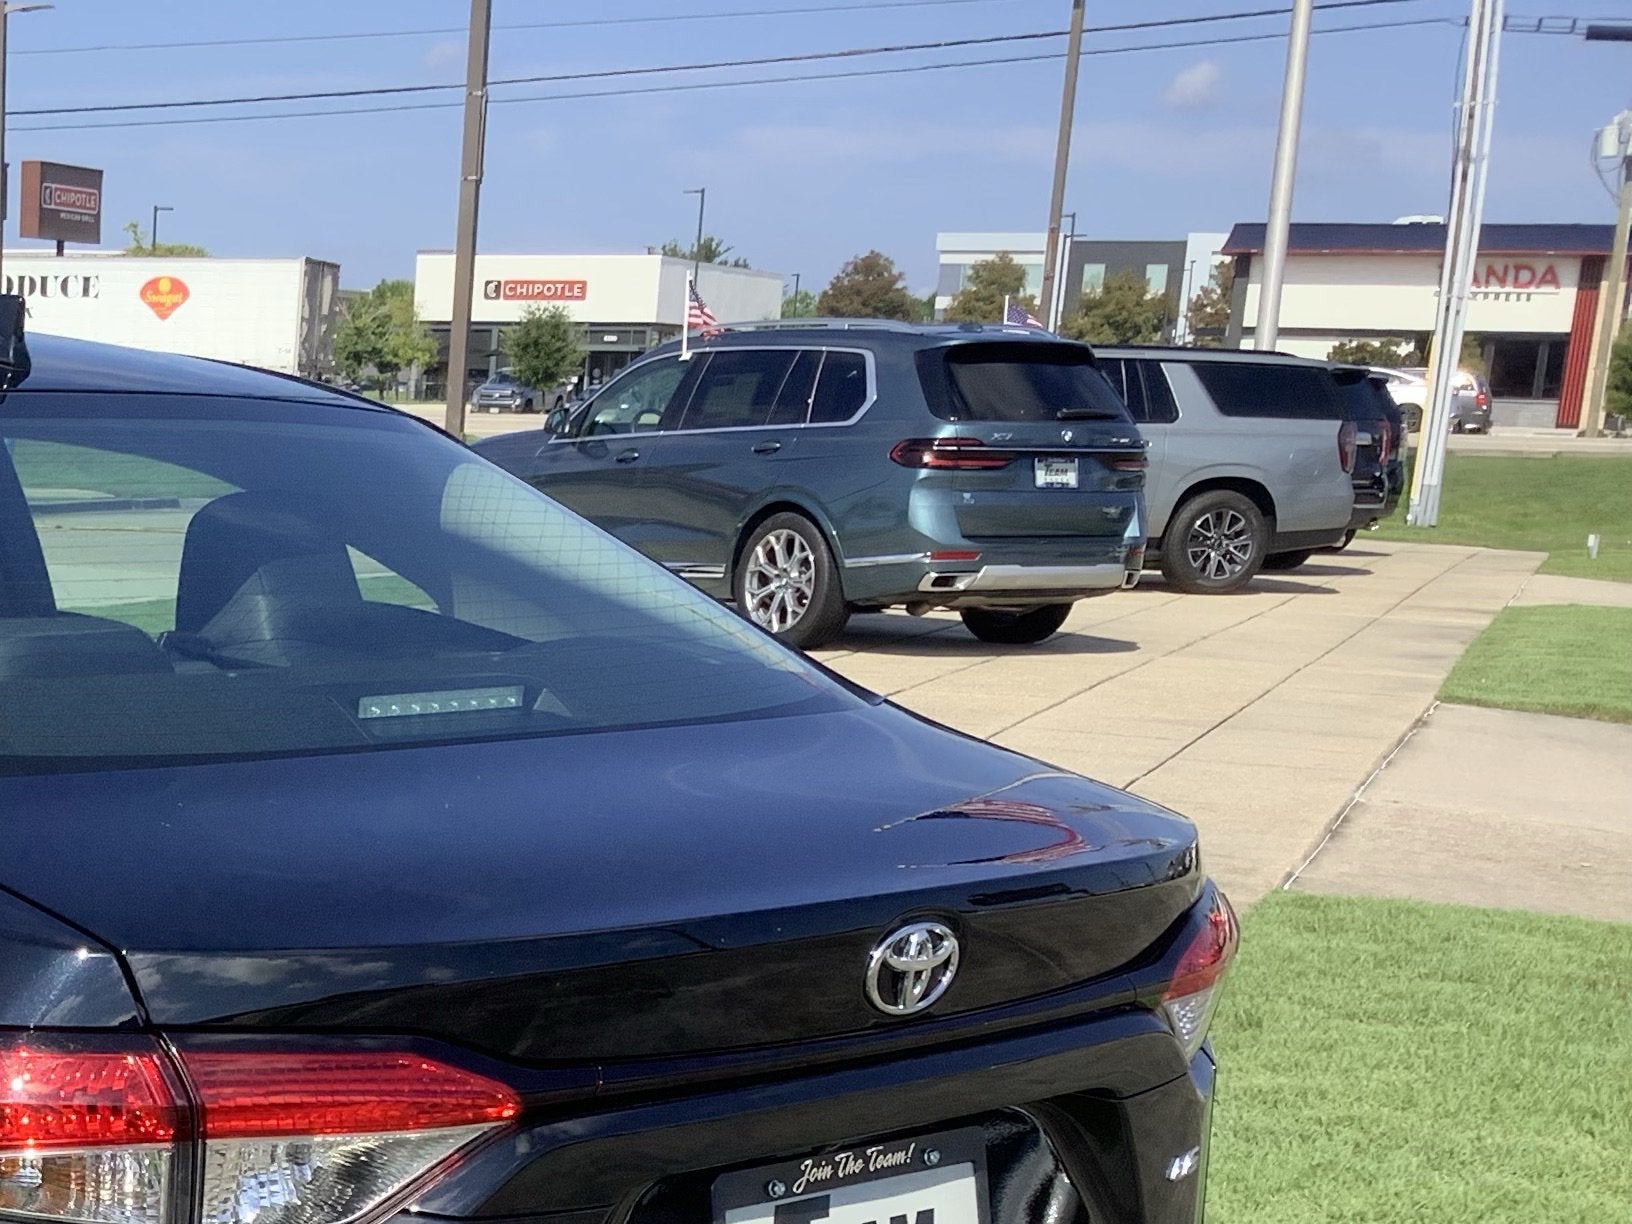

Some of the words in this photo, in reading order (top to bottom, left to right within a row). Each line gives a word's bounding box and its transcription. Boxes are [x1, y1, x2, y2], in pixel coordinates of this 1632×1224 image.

[55, 190, 96, 208] CHIPOTLE
[1472, 264, 1561, 289] NDA
[505, 283, 583, 297] CHIPOTLE
[792, 1159, 834, 1193] Join
[834, 1151, 865, 1178] The
[866, 1142, 916, 1172] Team!
